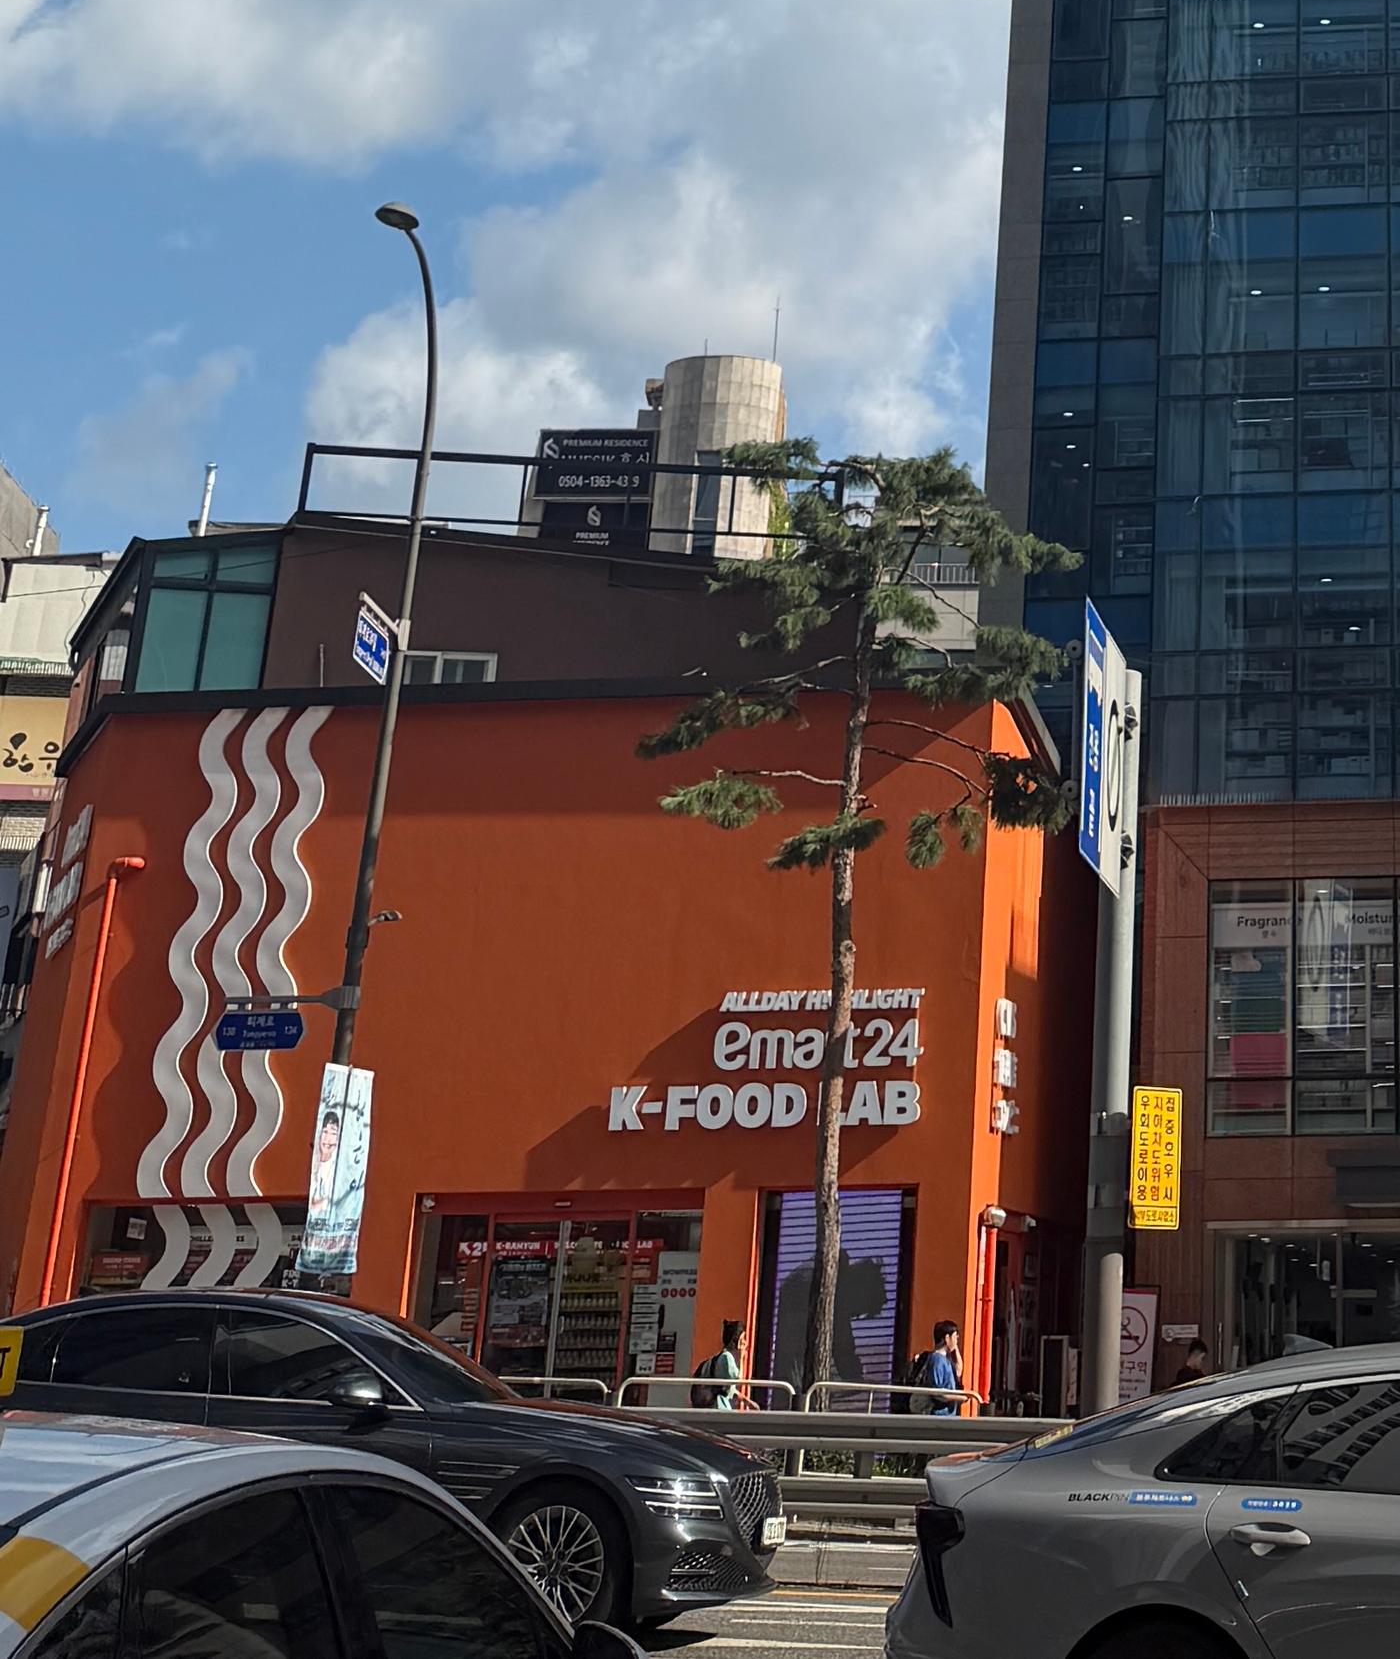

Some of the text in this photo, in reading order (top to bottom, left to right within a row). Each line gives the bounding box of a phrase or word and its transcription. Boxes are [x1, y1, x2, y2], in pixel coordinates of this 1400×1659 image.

[558, 474, 640, 488] 0504-1363-439
[718, 990, 807, 1013] ALLDAY
[712, 1018, 925, 1072] emat24
[607, 1082, 808, 1132] K-FOOD
